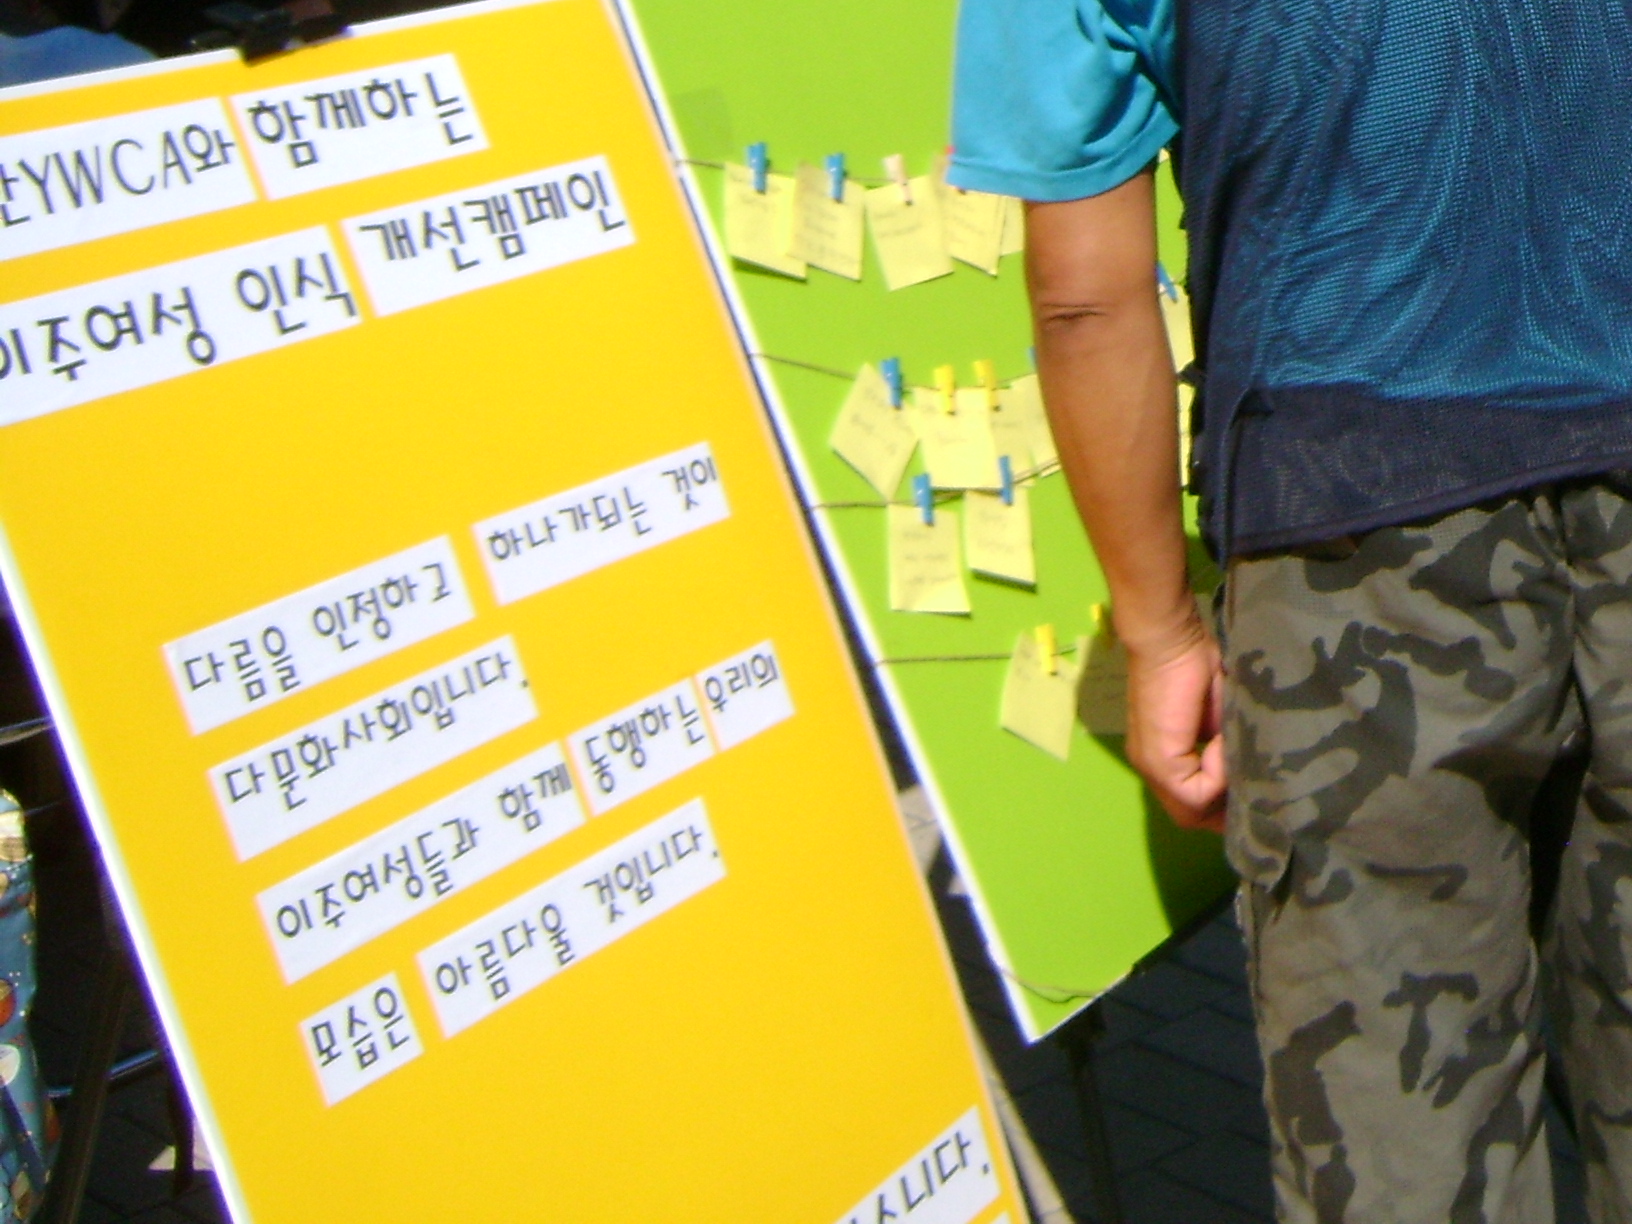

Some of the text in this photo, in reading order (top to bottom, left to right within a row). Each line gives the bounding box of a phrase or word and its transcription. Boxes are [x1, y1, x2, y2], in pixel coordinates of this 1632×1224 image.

[247, 72, 472, 169] 함께하는
[236, 251, 357, 336] 인식
[358, 170, 626, 272] 개선캠페인
[183, 626, 301, 703] 다름을
[313, 562, 452, 652] 인정하고
[661, 454, 718, 511] 것이
[224, 649, 530, 810] 다문화사회입니다.
[276, 652, 779, 931] 이주여성들과 함께 동행하는 우리의
[311, 825, 720, 1072] 모습은 아름다울 것입니다.
